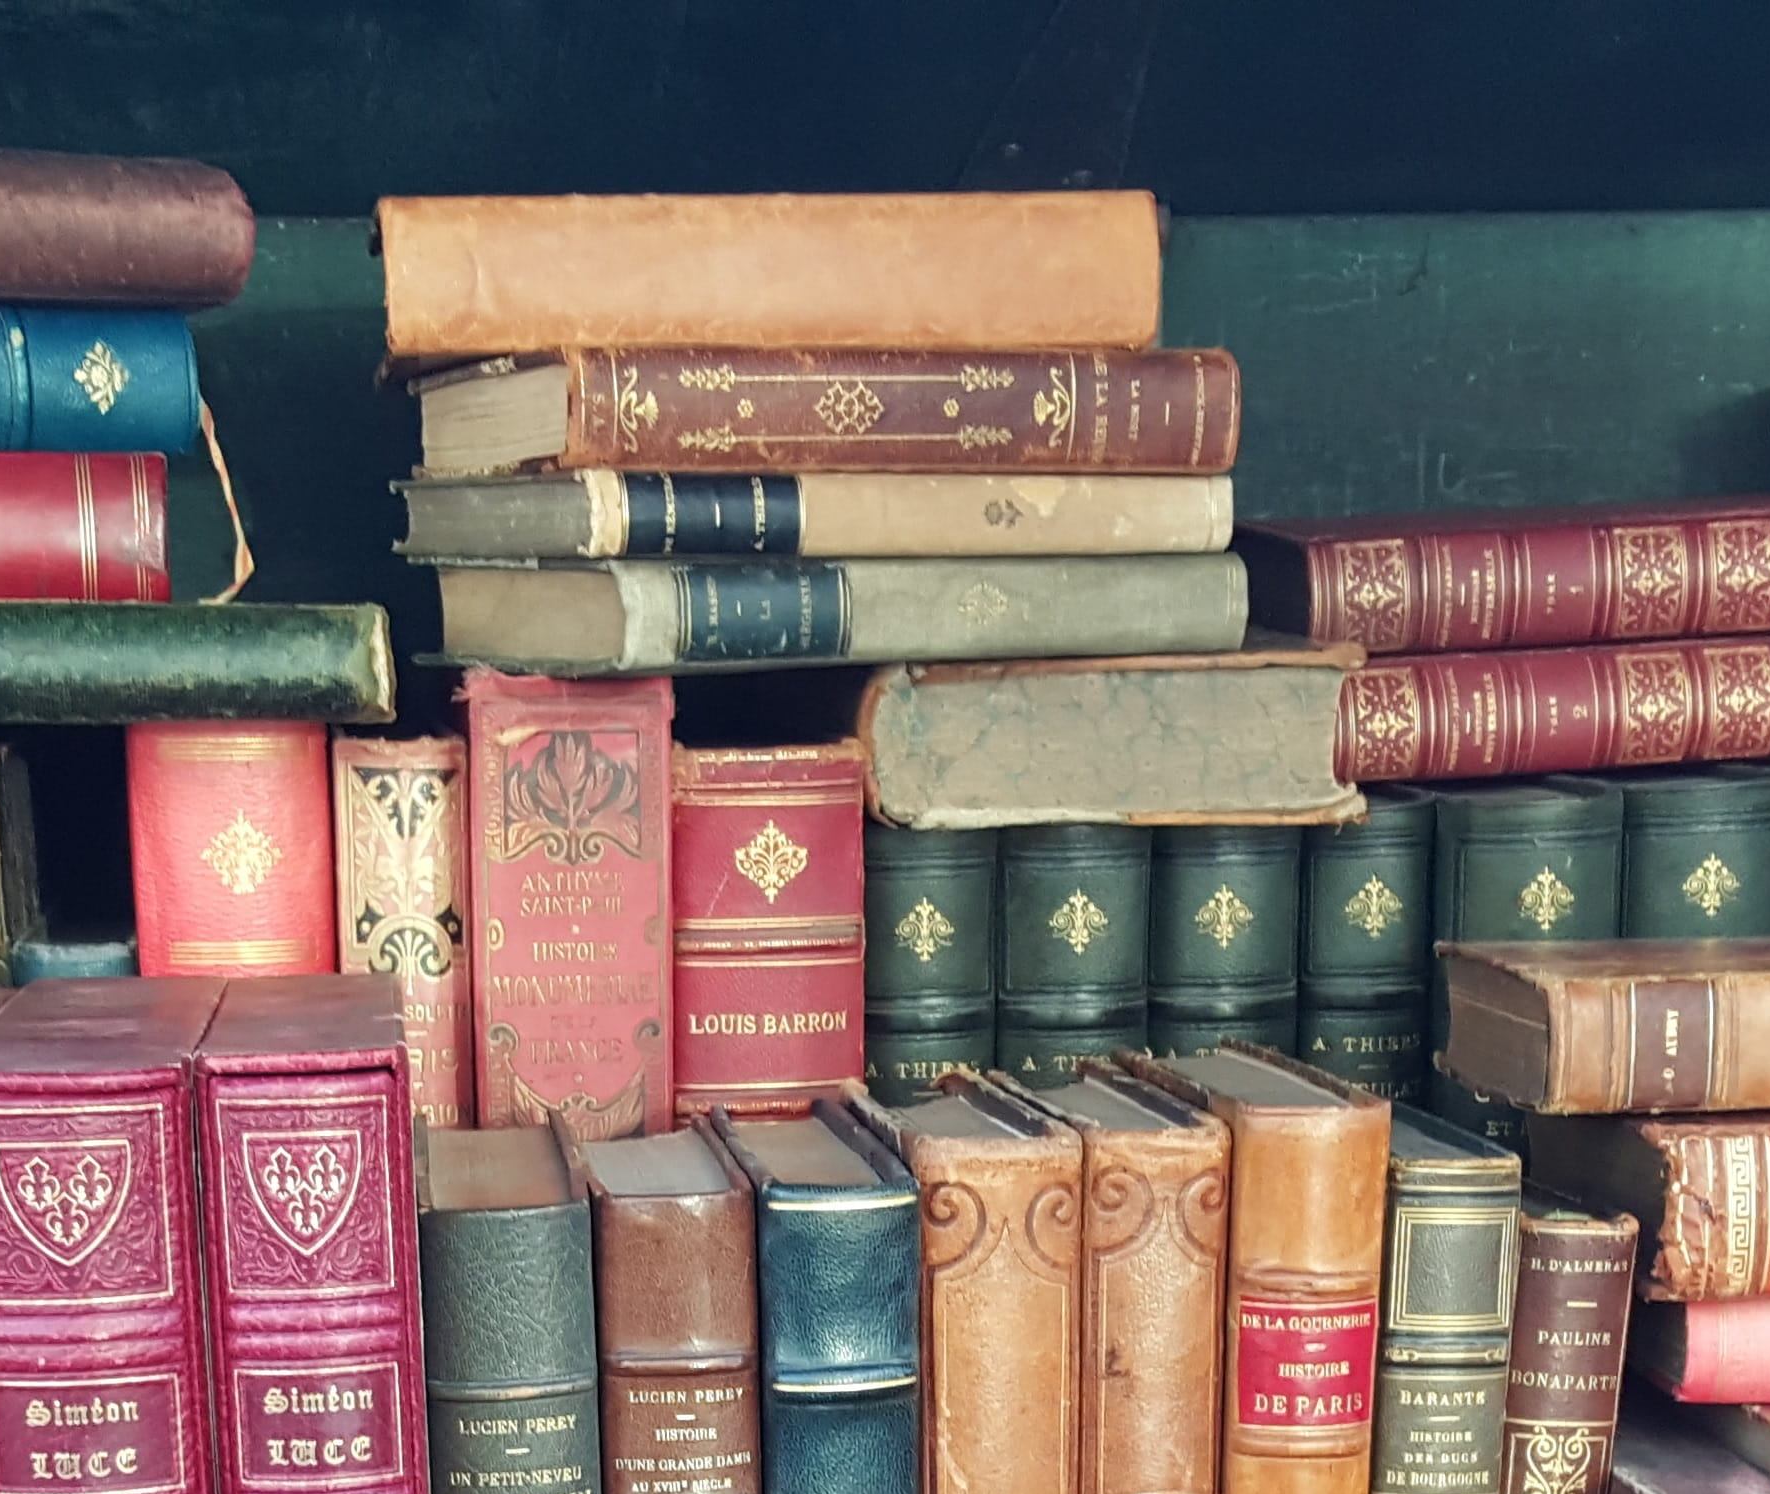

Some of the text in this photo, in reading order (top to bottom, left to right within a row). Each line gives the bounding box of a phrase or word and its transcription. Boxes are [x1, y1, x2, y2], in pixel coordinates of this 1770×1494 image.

[688, 1010, 849, 1036] LOUIS BARRON
[1241, 1312, 1372, 1333] DE LA GOURNERIE
[1537, 1330, 1611, 1347] PAULINE
[1277, 1360, 1350, 1378] HISTOIRE
[1509, 1373, 1617, 1392] BONAPARTE
[263, 1385, 375, 1416] Siméon
[629, 1387, 745, 1405] LUCIEN PEREY
[1254, 1392, 1364, 1418] DE PARIS
[1399, 1389, 1486, 1407] BARANTE
[25, 1396, 141, 1429] Siméon
[459, 1414, 578, 1435] LUCIEN PEREY
[655, 1427, 719, 1443] HISTOIRE
[266, 1435, 373, 1468] LUCE
[615, 1450, 752, 1472] D'UNE GRANDE DAME
[30, 1447, 139, 1481] LUCE
[1385, 1468, 1490, 1488] DE BOURGOGNE
